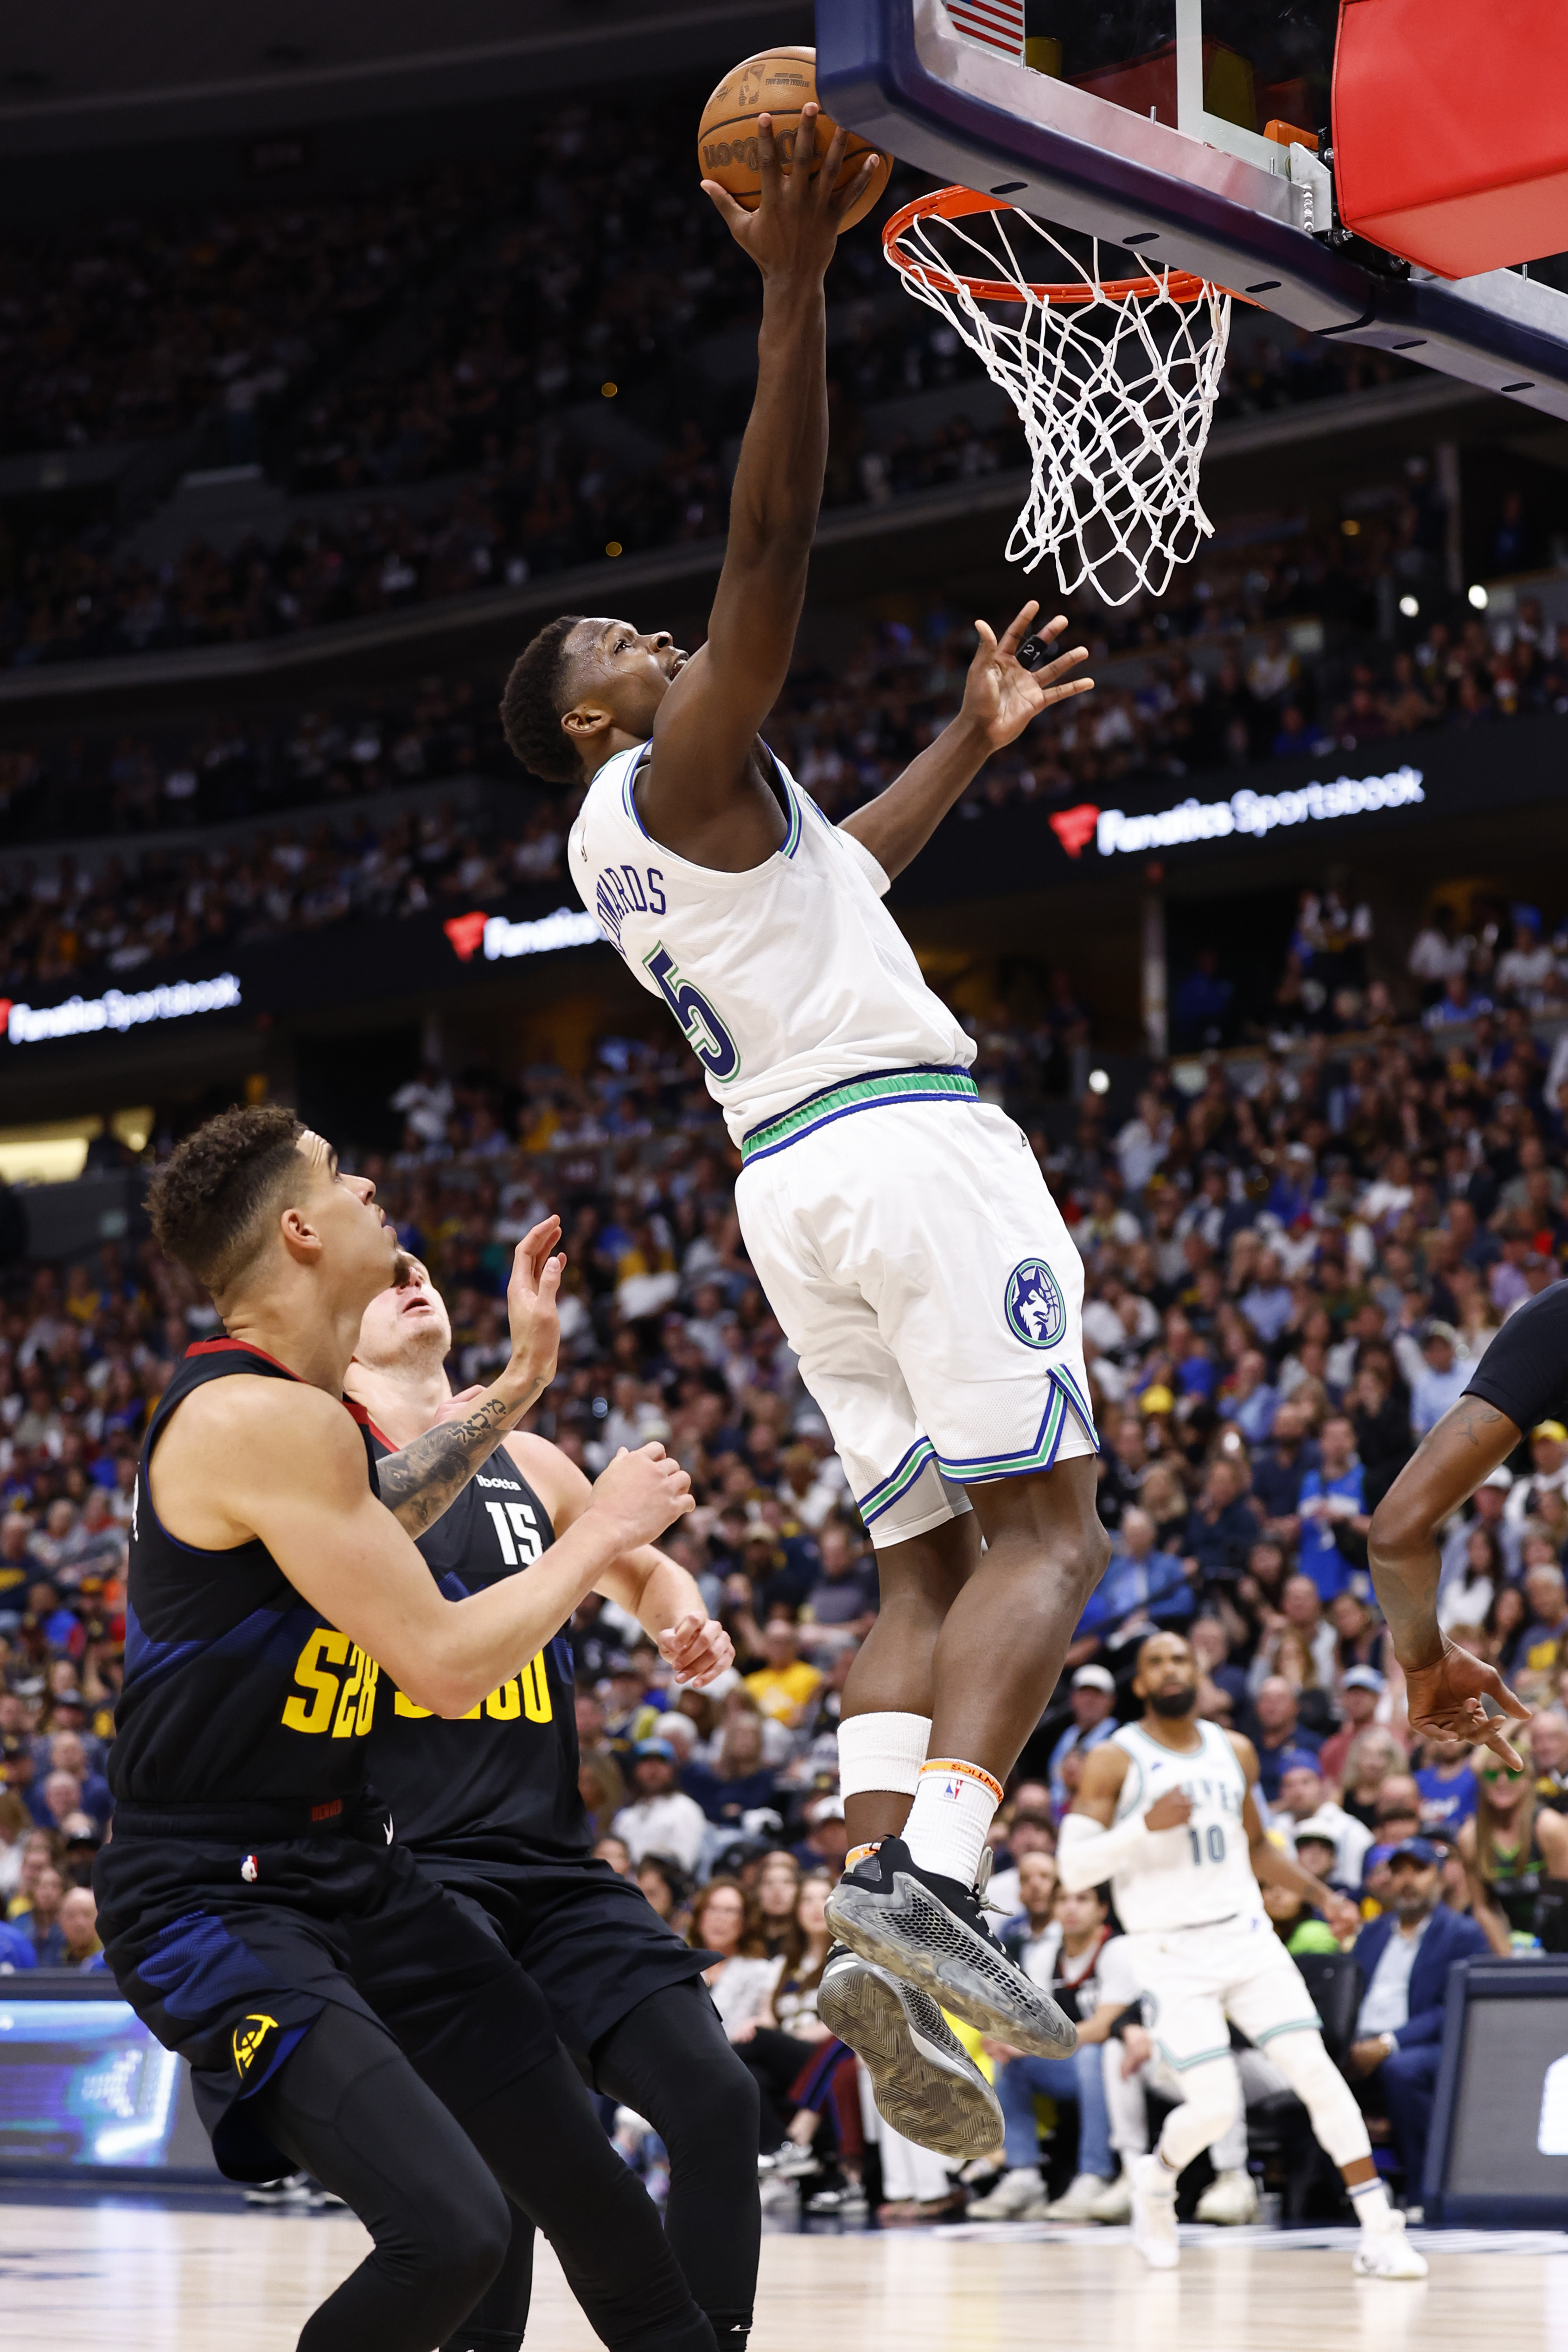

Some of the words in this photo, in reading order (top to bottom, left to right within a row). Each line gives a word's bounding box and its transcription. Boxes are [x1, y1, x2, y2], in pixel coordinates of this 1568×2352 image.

[1023, 644, 1040, 661] 21
[1097, 797, 1234, 856] Fanatics
[1231, 765, 1425, 837] Sportsbook
[8, 995, 107, 1044] Fanatics
[102, 971, 242, 1032] Sportsbook
[642, 940, 741, 1083] 5
[476, 1474, 522, 1491] ibotta
[484, 1501, 543, 1566] 15
[1188, 1825, 1225, 1866] 10
